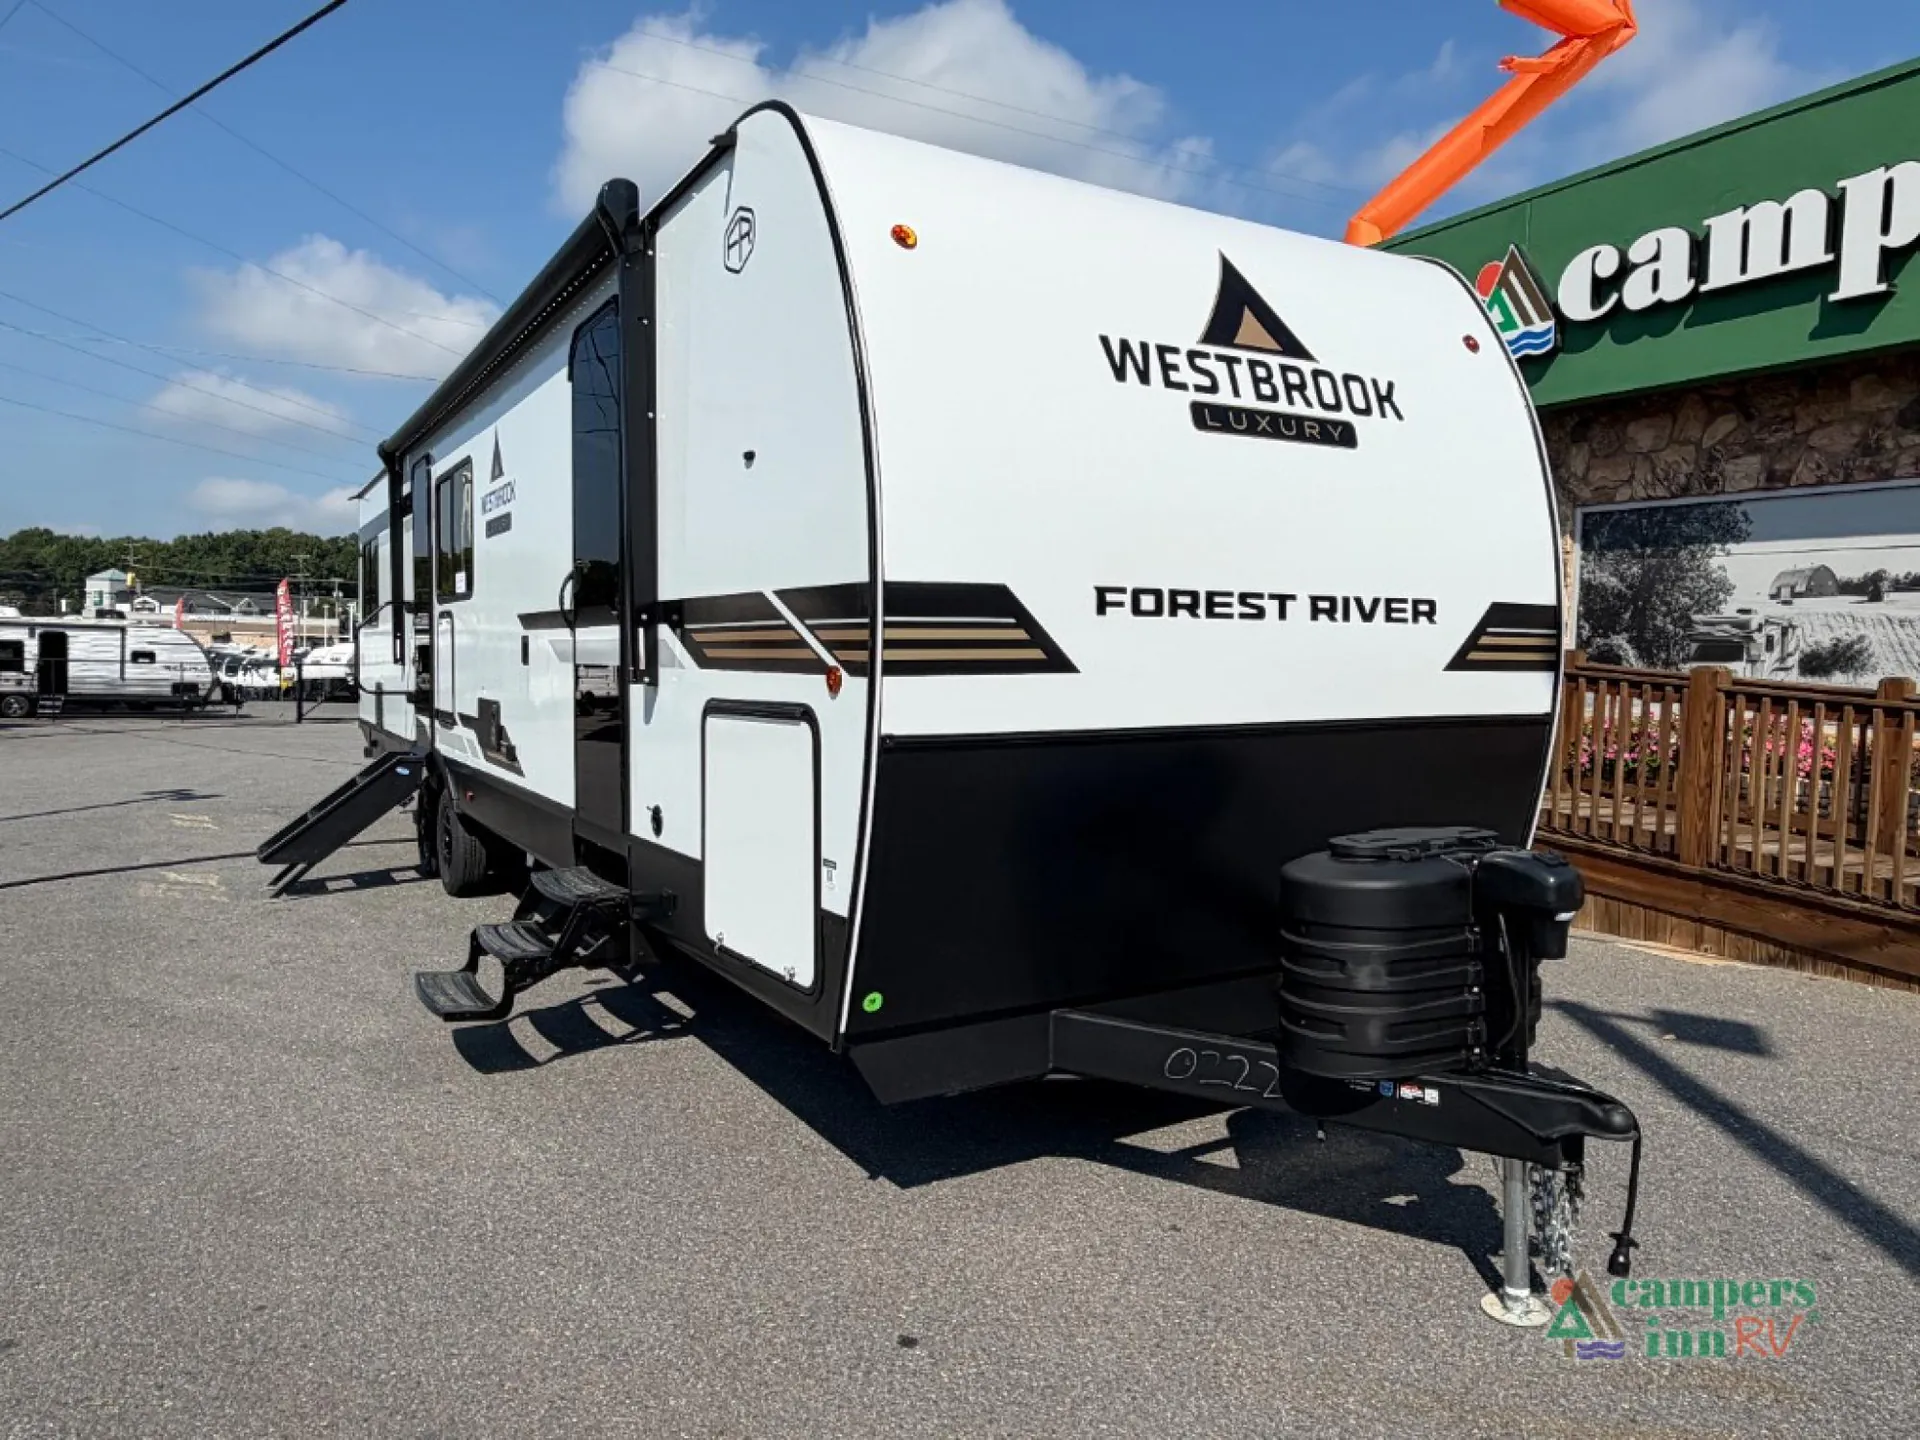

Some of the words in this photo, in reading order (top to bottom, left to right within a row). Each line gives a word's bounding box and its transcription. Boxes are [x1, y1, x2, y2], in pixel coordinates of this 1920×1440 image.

[1098, 333, 1404, 421] WESTBROOK
[1204, 407, 1344, 442] LUXURY
[1093, 585, 1298, 621] FOREST
[1308, 593, 1437, 625] RIVER
